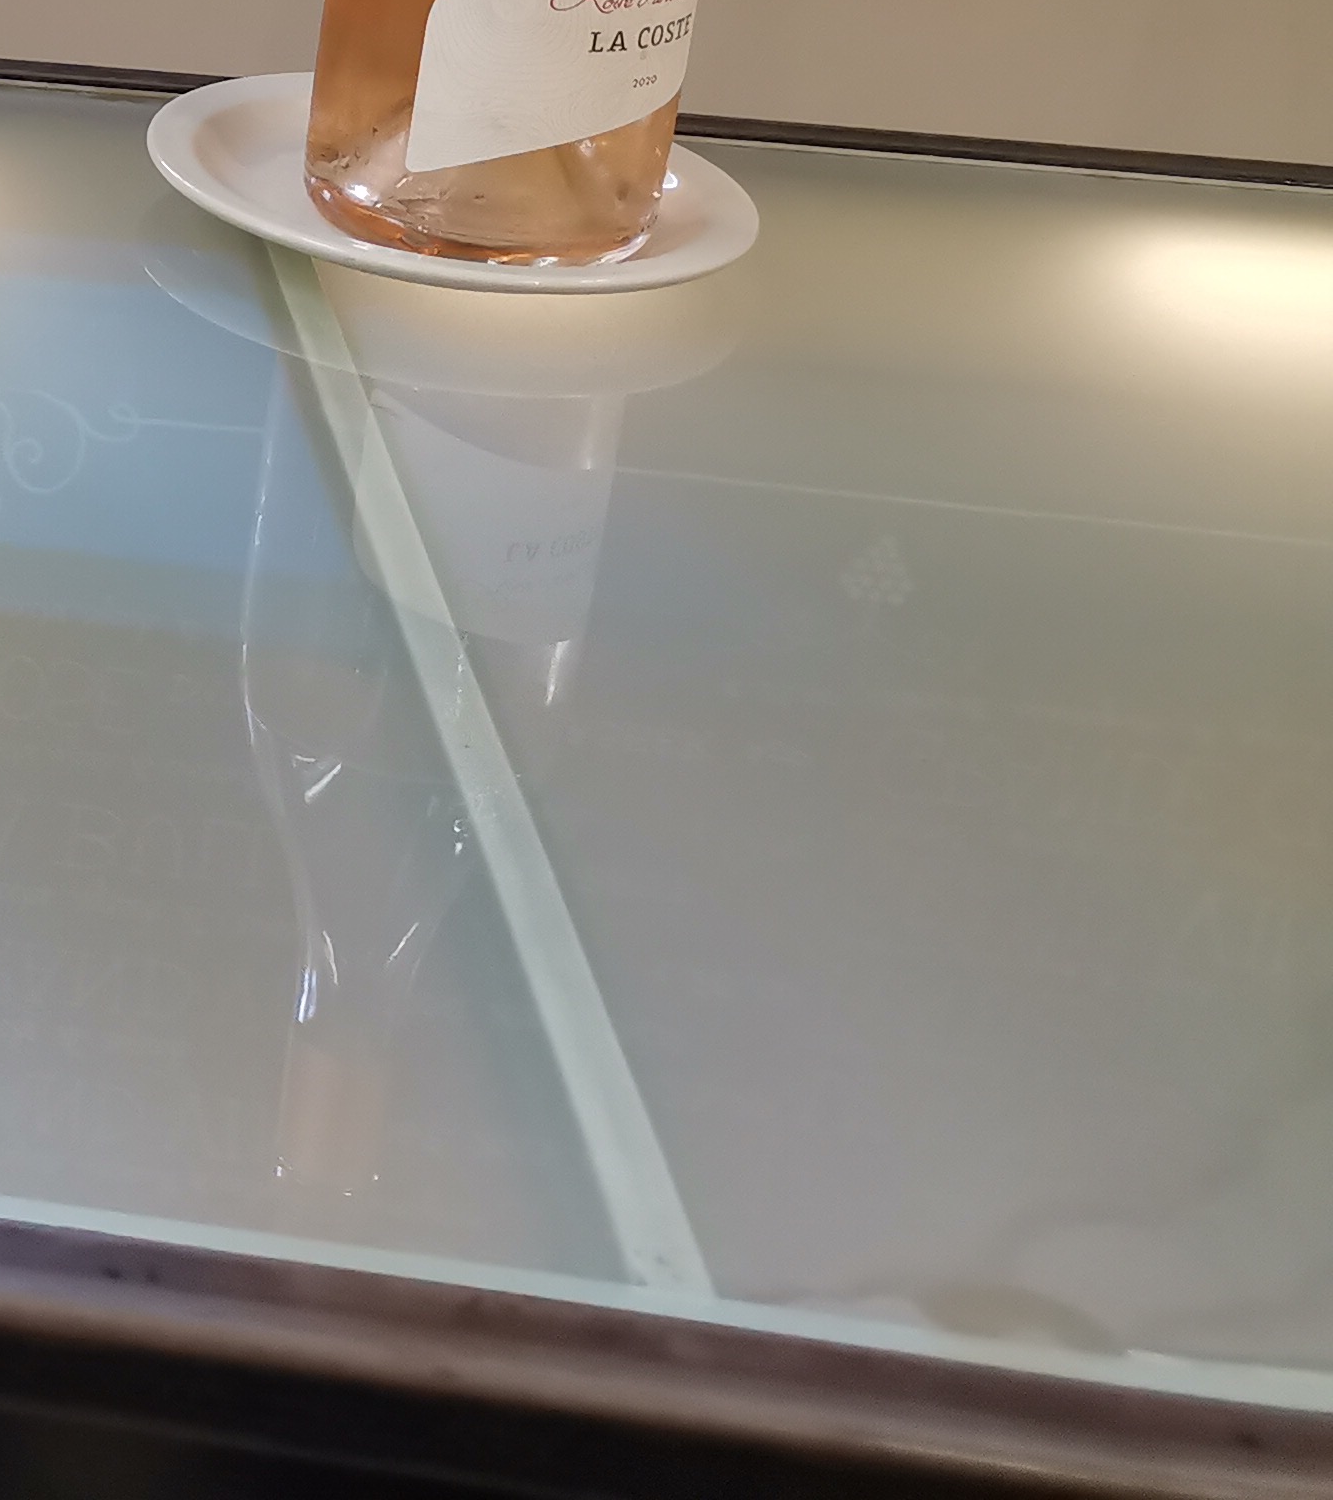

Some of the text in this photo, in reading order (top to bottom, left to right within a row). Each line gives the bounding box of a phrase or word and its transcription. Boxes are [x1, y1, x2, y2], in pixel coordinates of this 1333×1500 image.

[588, 13, 693, 53] LA COSTE
[632, 74, 658, 89] 2020
